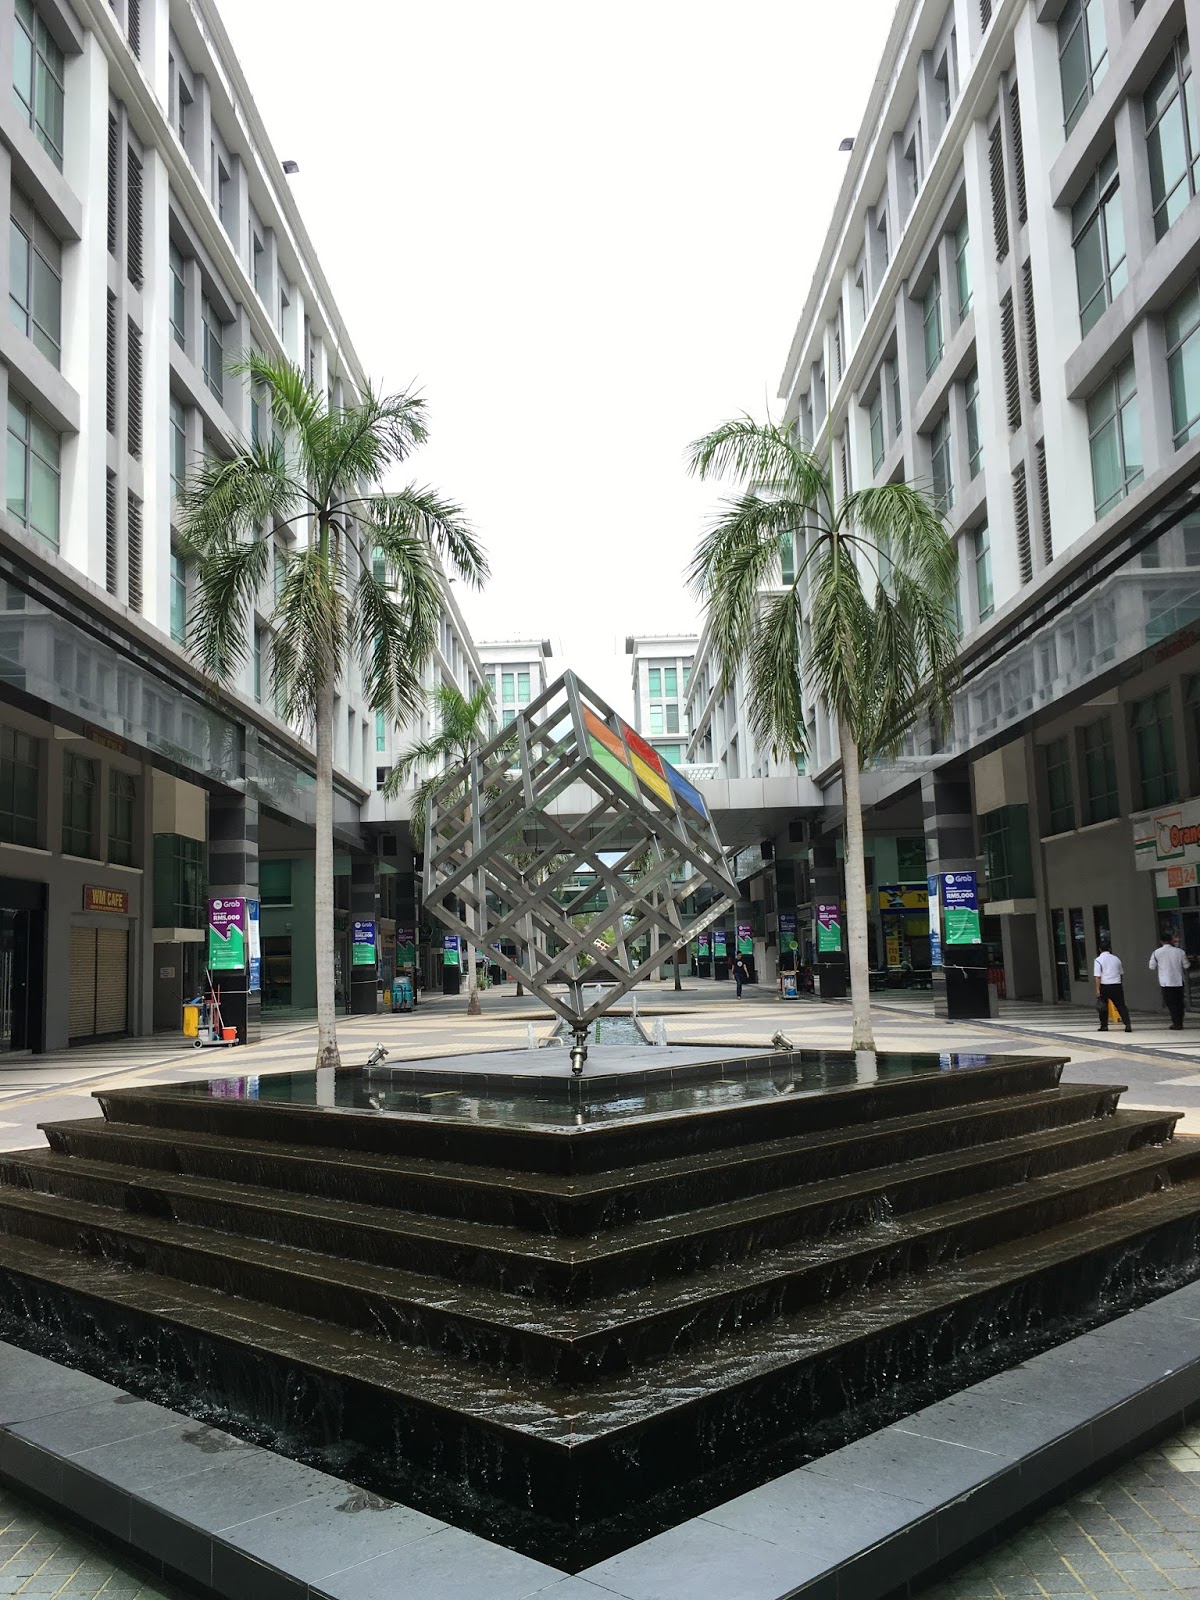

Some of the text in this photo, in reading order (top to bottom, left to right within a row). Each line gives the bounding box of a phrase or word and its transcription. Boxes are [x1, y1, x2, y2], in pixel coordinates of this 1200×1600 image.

[92, 889, 122, 907] WM CAFE
[223, 900, 241, 908] Grab
